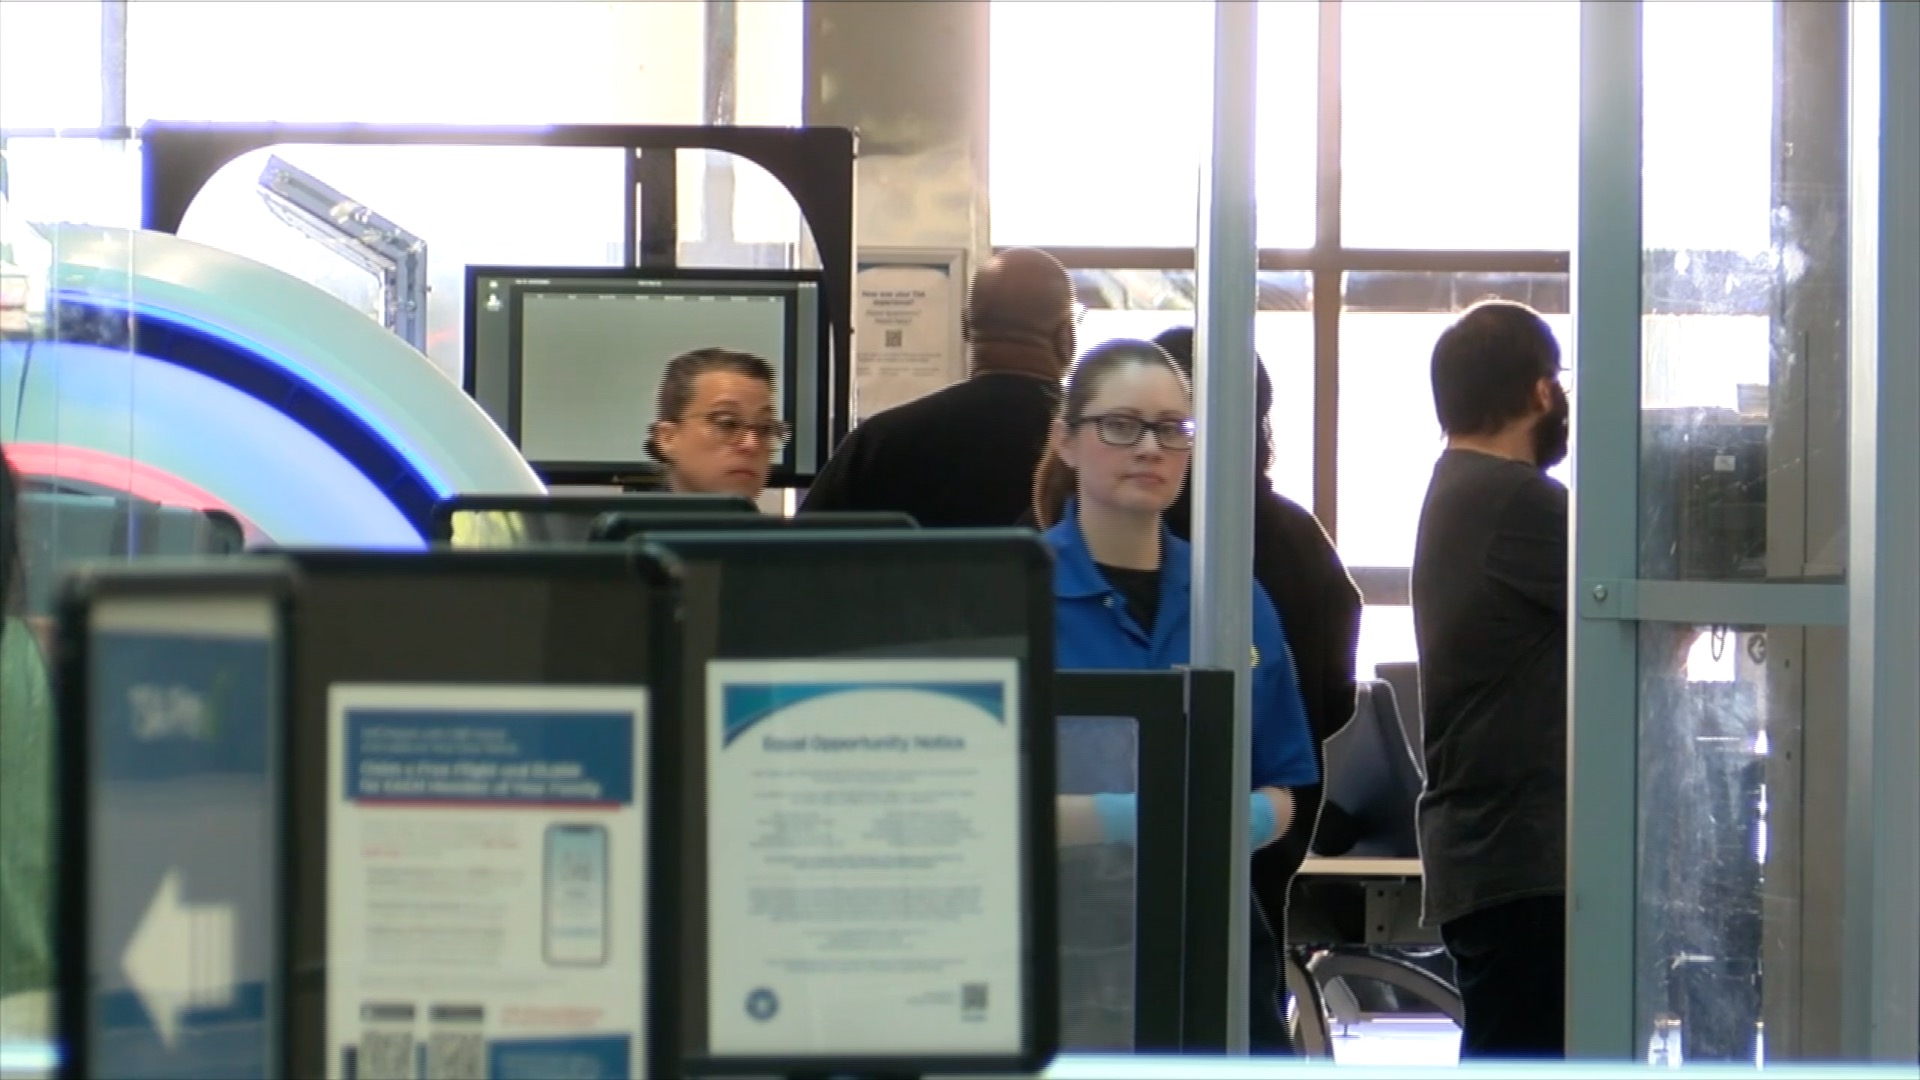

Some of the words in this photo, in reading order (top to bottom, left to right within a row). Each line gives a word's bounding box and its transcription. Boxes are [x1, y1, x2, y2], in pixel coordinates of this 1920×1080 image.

[762, 737, 806, 753] Equal
[811, 736, 909, 754] Opportunity
[914, 735, 965, 750] Notice
